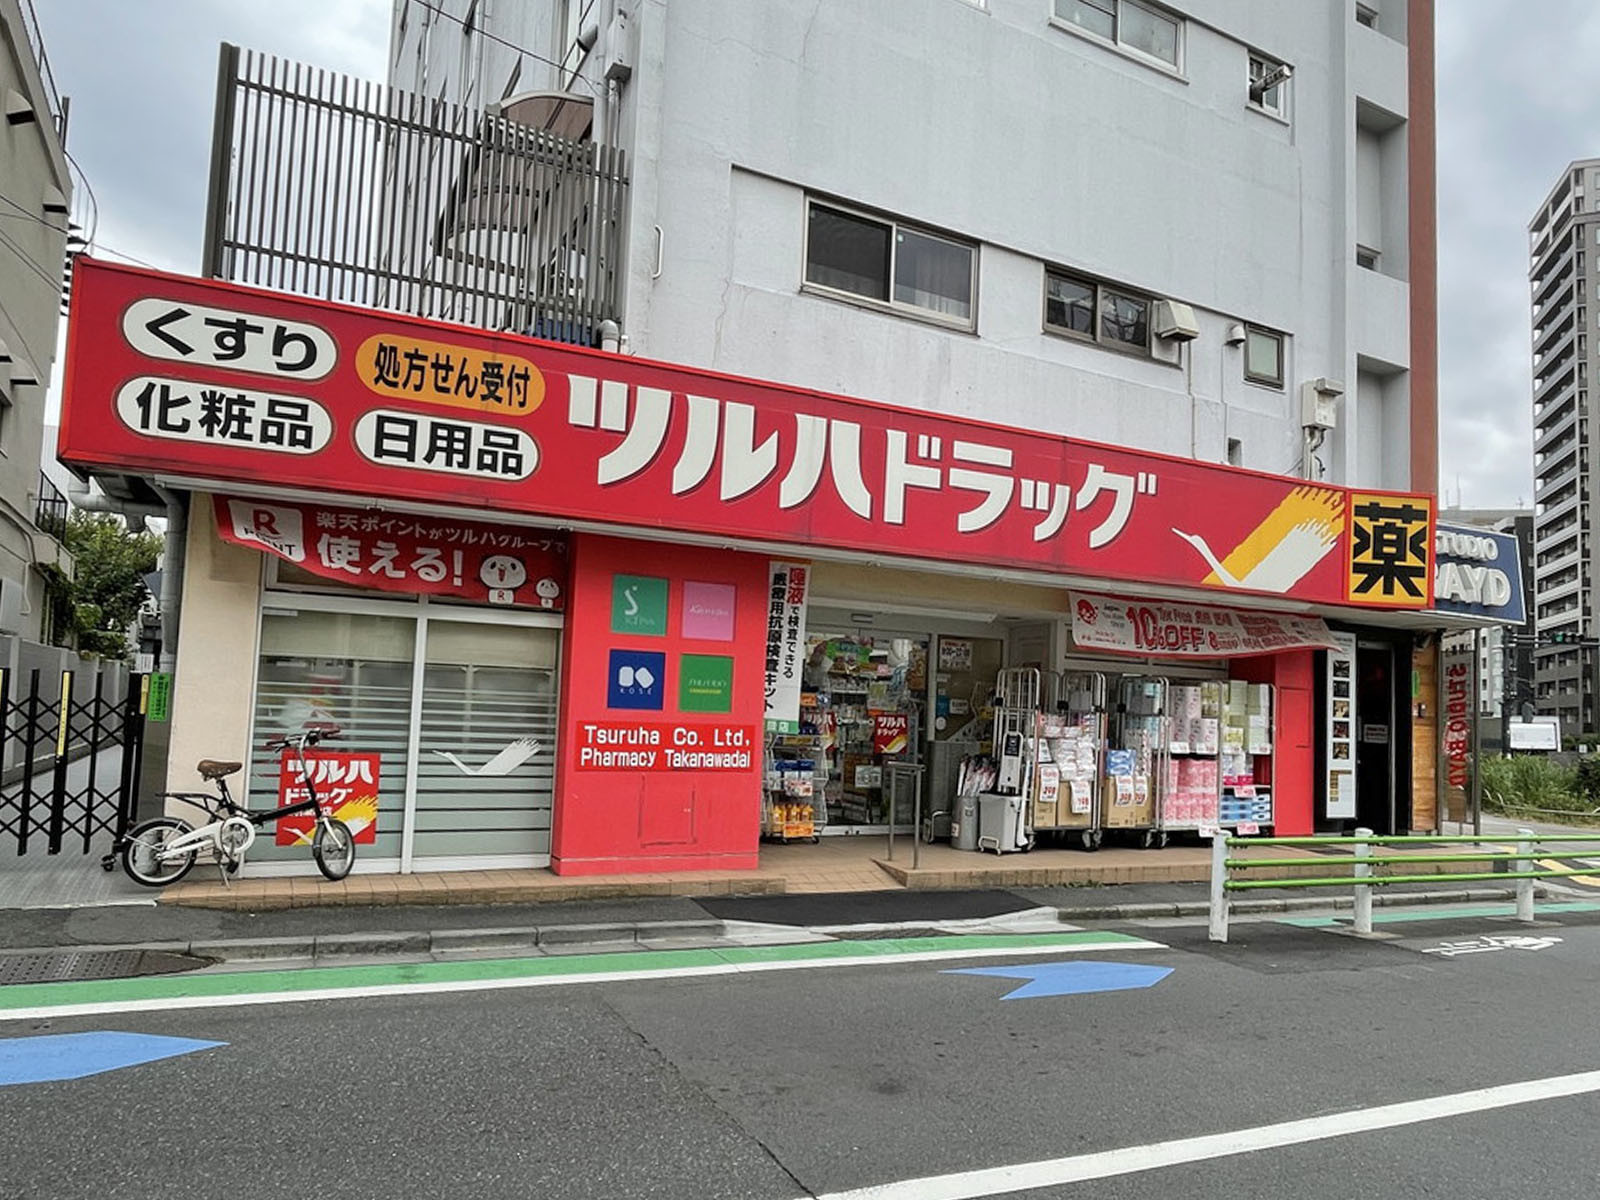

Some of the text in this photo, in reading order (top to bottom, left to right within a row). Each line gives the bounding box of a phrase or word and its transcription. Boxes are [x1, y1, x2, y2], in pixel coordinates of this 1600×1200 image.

[144, 308, 318, 371] くすり
[373, 342, 532, 409] 処方せん受付
[136, 381, 314, 449] 化粧品
[375, 413, 524, 477] 日用品
[568, 373, 1158, 549] ツルハドラッグ
[316, 511, 566, 553] 楽天ポイントがツルハグループで
[1352, 501, 1428, 598] 薬
[1435, 530, 1499, 560] TUDIO
[317, 533, 463, 587] 使える!
[1434, 561, 1512, 607] AYD
[584, 725, 660, 745] Tsuruha
[673, 727, 704, 746] Co.
[877, 716, 907, 729] ツルハ
[581, 747, 656, 768] Pharmacy
